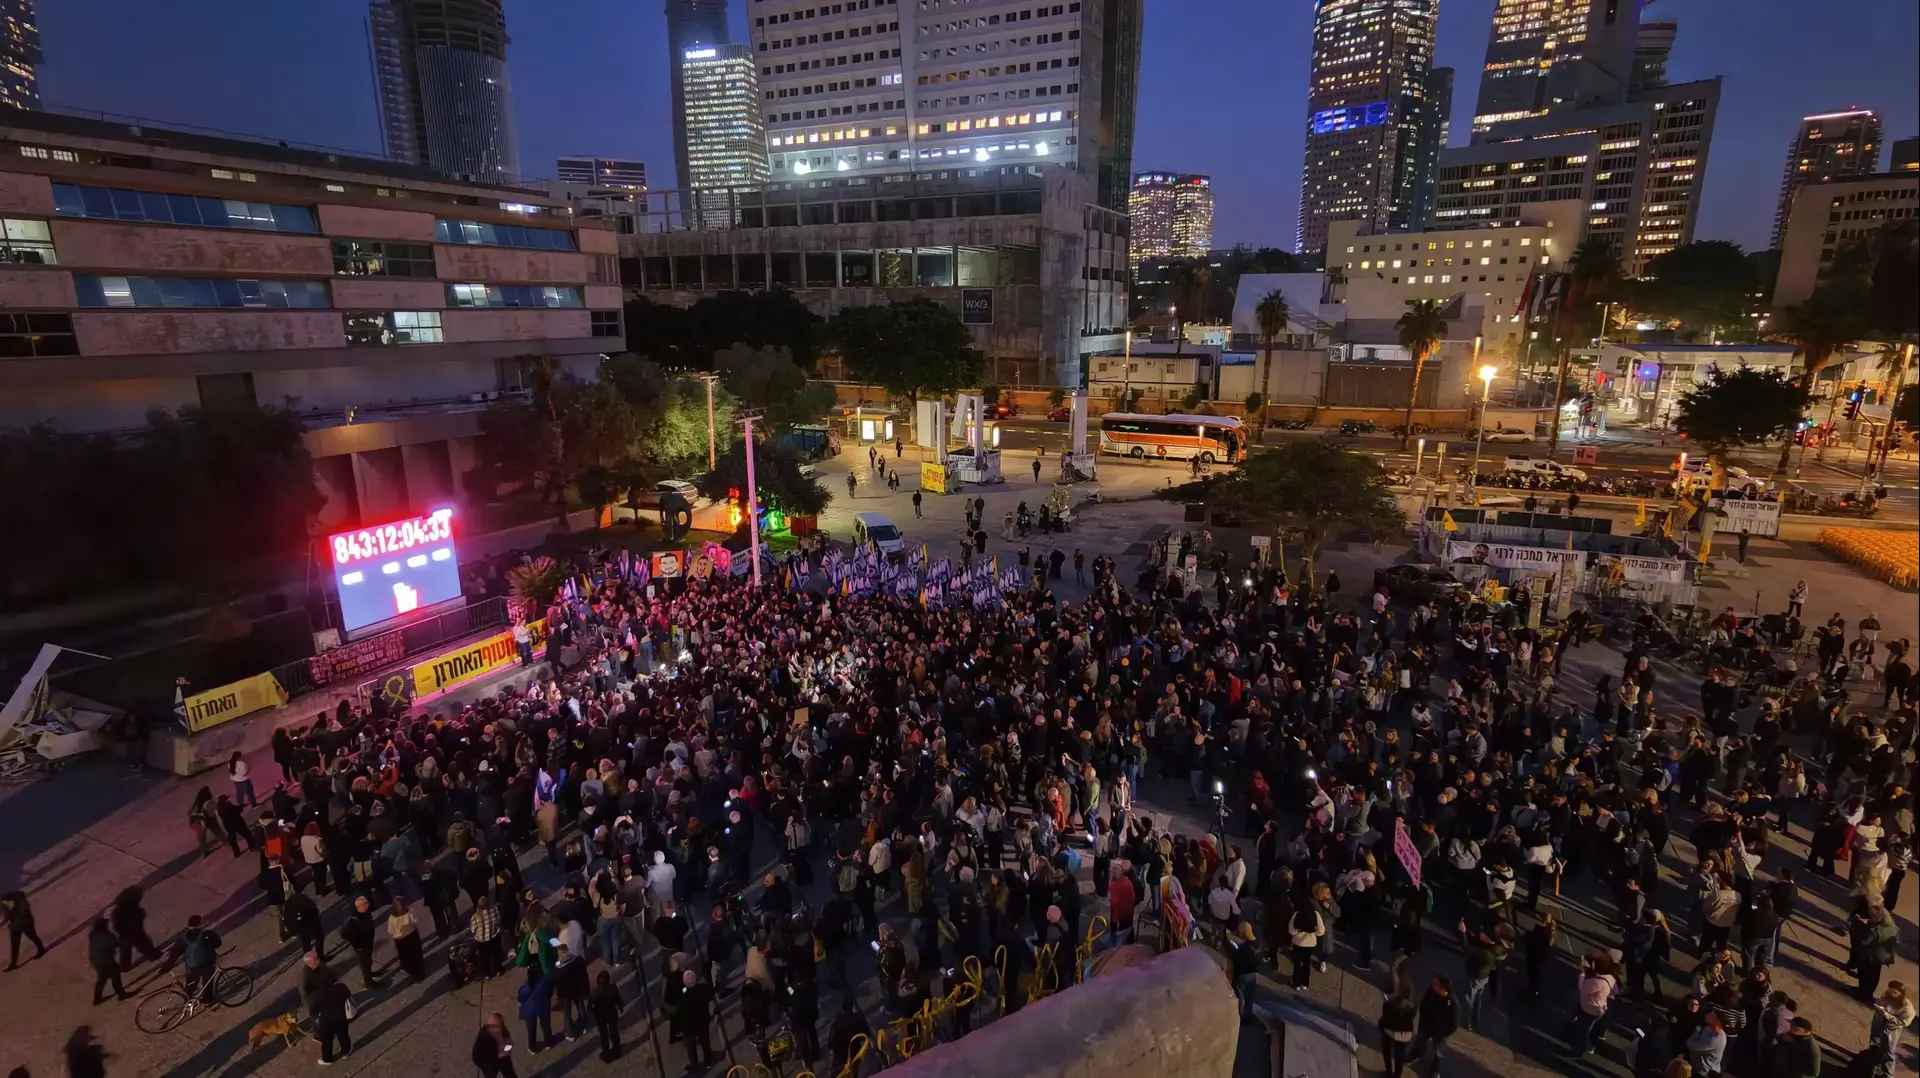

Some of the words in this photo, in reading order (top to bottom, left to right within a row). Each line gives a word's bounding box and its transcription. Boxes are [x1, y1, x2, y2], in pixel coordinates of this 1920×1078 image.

[965, 300, 988, 309] WXG
[1495, 547, 1514, 560] לרני
[1516, 549, 1543, 562] מחכה
[1546, 550, 1579, 562] ישראל
[432, 648, 484, 688] האחרון
[190, 693, 238, 724] האחרון
